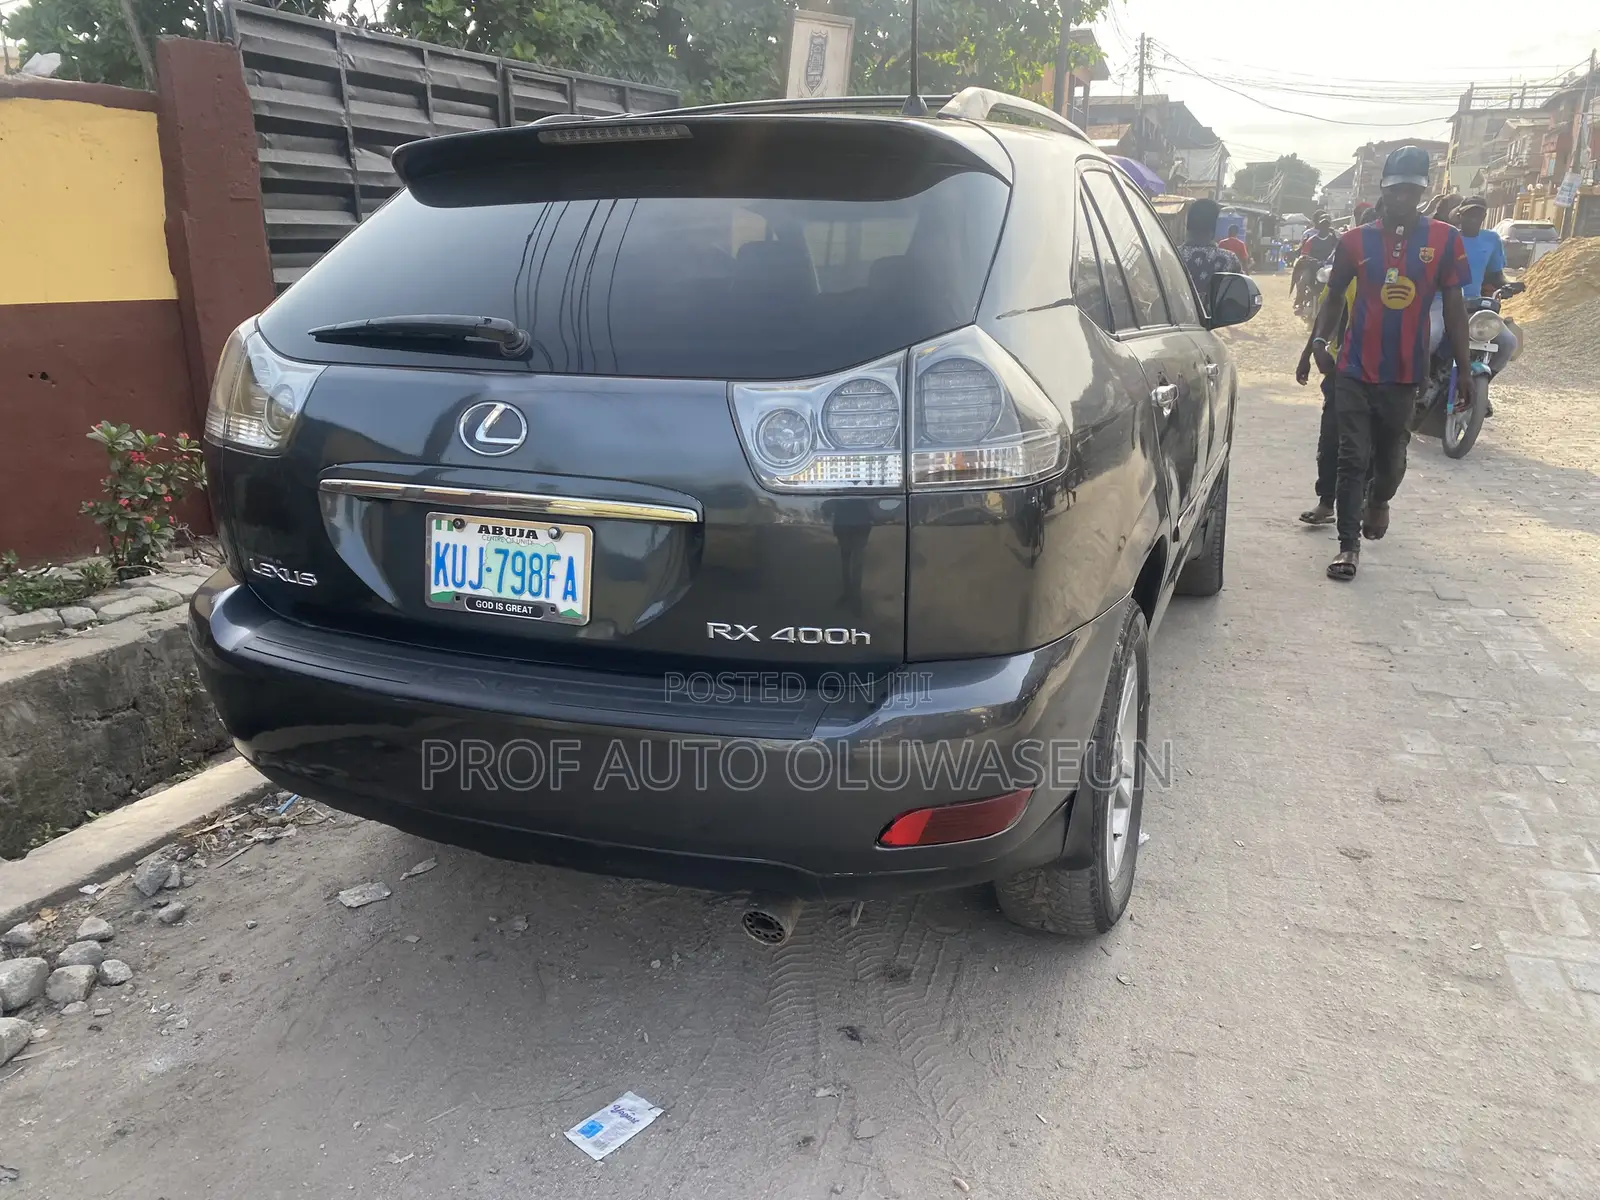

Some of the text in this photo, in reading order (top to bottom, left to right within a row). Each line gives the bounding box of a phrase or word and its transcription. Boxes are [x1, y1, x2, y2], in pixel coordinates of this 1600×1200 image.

[477, 524, 539, 540] ABUJA
[249, 558, 318, 587] LEXUS
[475, 599, 533, 614] GOD IS GREAT
[706, 621, 871, 645] RX 400h
